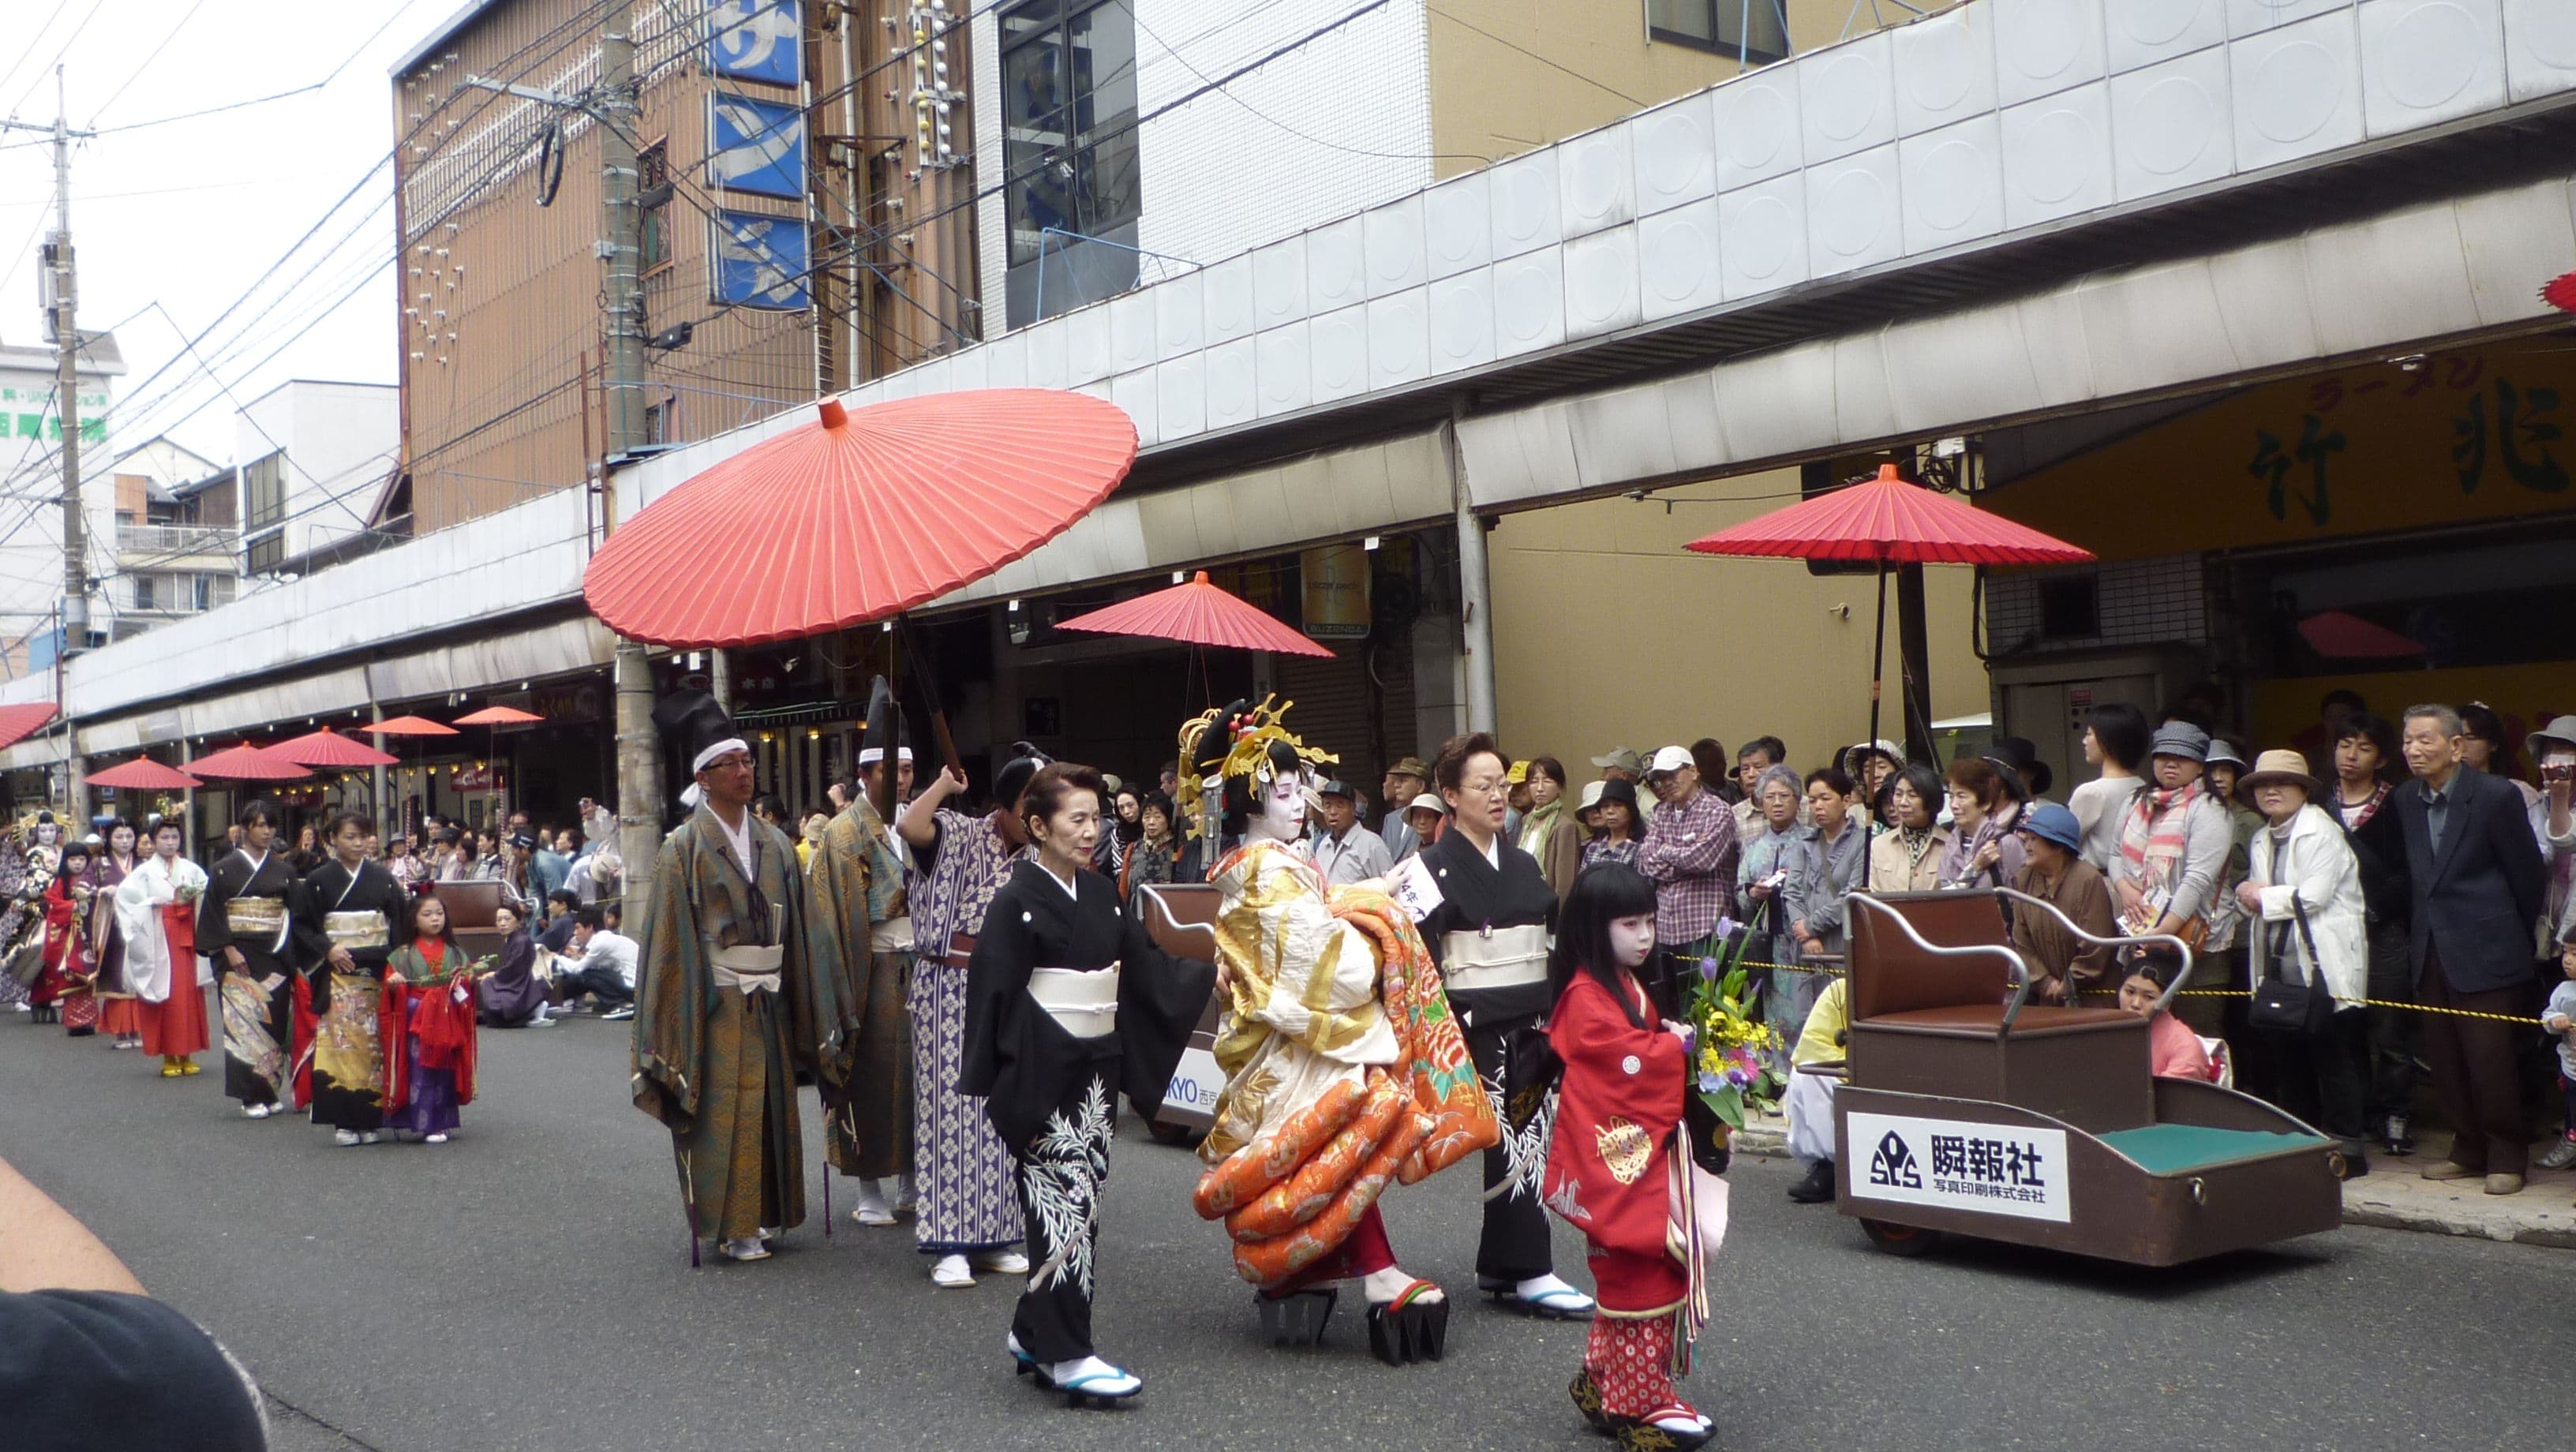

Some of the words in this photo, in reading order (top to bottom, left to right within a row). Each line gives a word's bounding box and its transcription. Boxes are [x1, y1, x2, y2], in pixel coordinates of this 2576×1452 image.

[2309, 357, 2484, 413] ラーメン
[1310, 624, 1363, 633] BUZENDA
[1930, 1134, 2045, 1187] 瞬報社
[1933, 1178, 2046, 1204] 写真印刷株式会社
